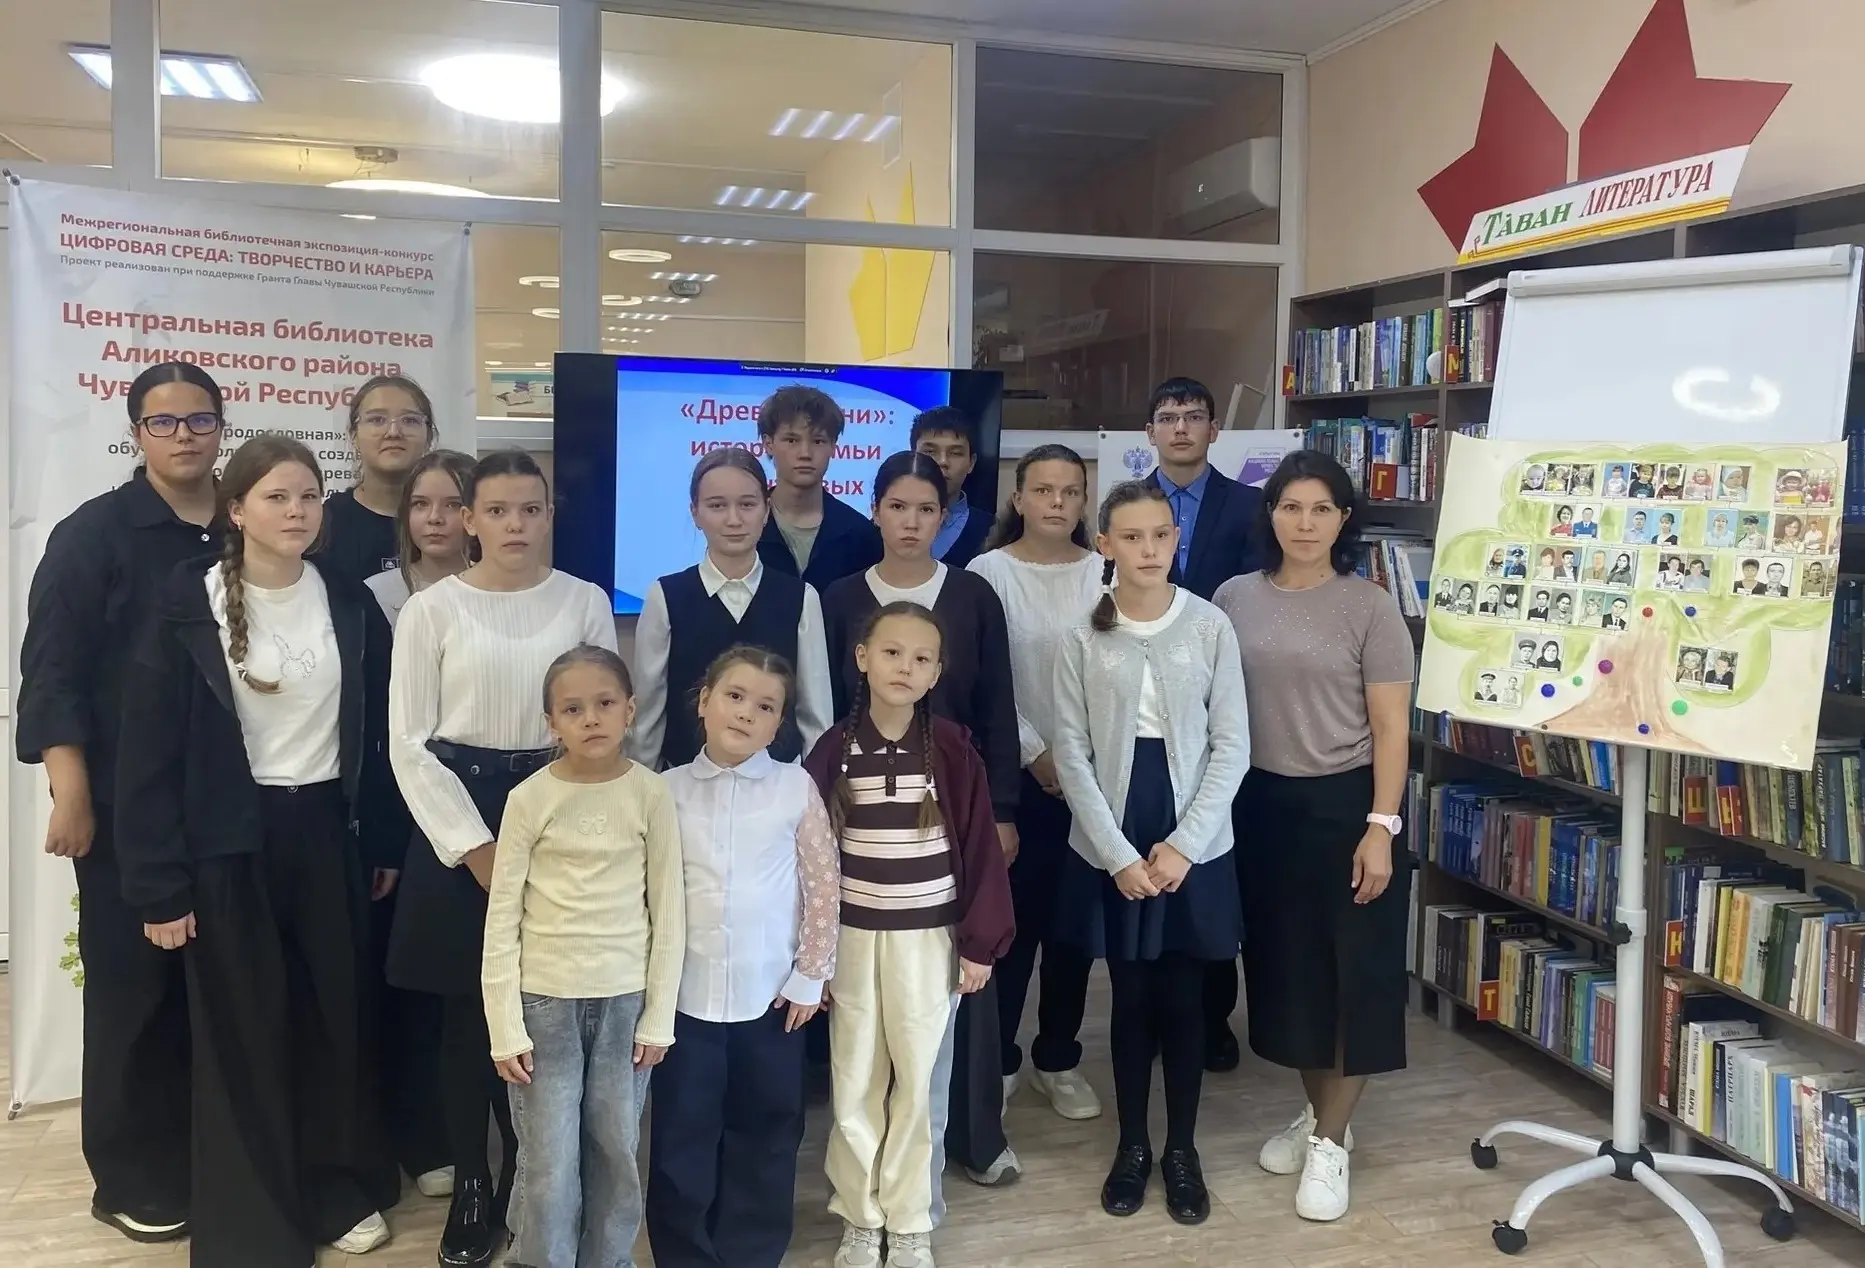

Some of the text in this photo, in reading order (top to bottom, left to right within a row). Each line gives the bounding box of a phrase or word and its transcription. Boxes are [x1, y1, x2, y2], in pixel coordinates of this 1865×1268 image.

[1578, 160, 1714, 219] ЛИТЕРАТУРА
[60, 213, 435, 262] Межрегиональная библиотечная экспозиция-конкурс
[60, 233, 434, 281] ЦИФРОВАЯ СРЕДА: ТВОРЧЕСТВО И КАРЬЕРА
[60, 254, 435, 297] Проект реализован при поддержке Гранта Главы Чувашской Республики
[62, 301, 434, 348] Центральная библиотека
[101, 340, 402, 378] Аликовского района
[258, 382, 358, 411] Респуб
[680, 399, 761, 425] «Древ
[1376, 470, 1388, 491] Г
[1483, 988, 1497, 1011] Т
